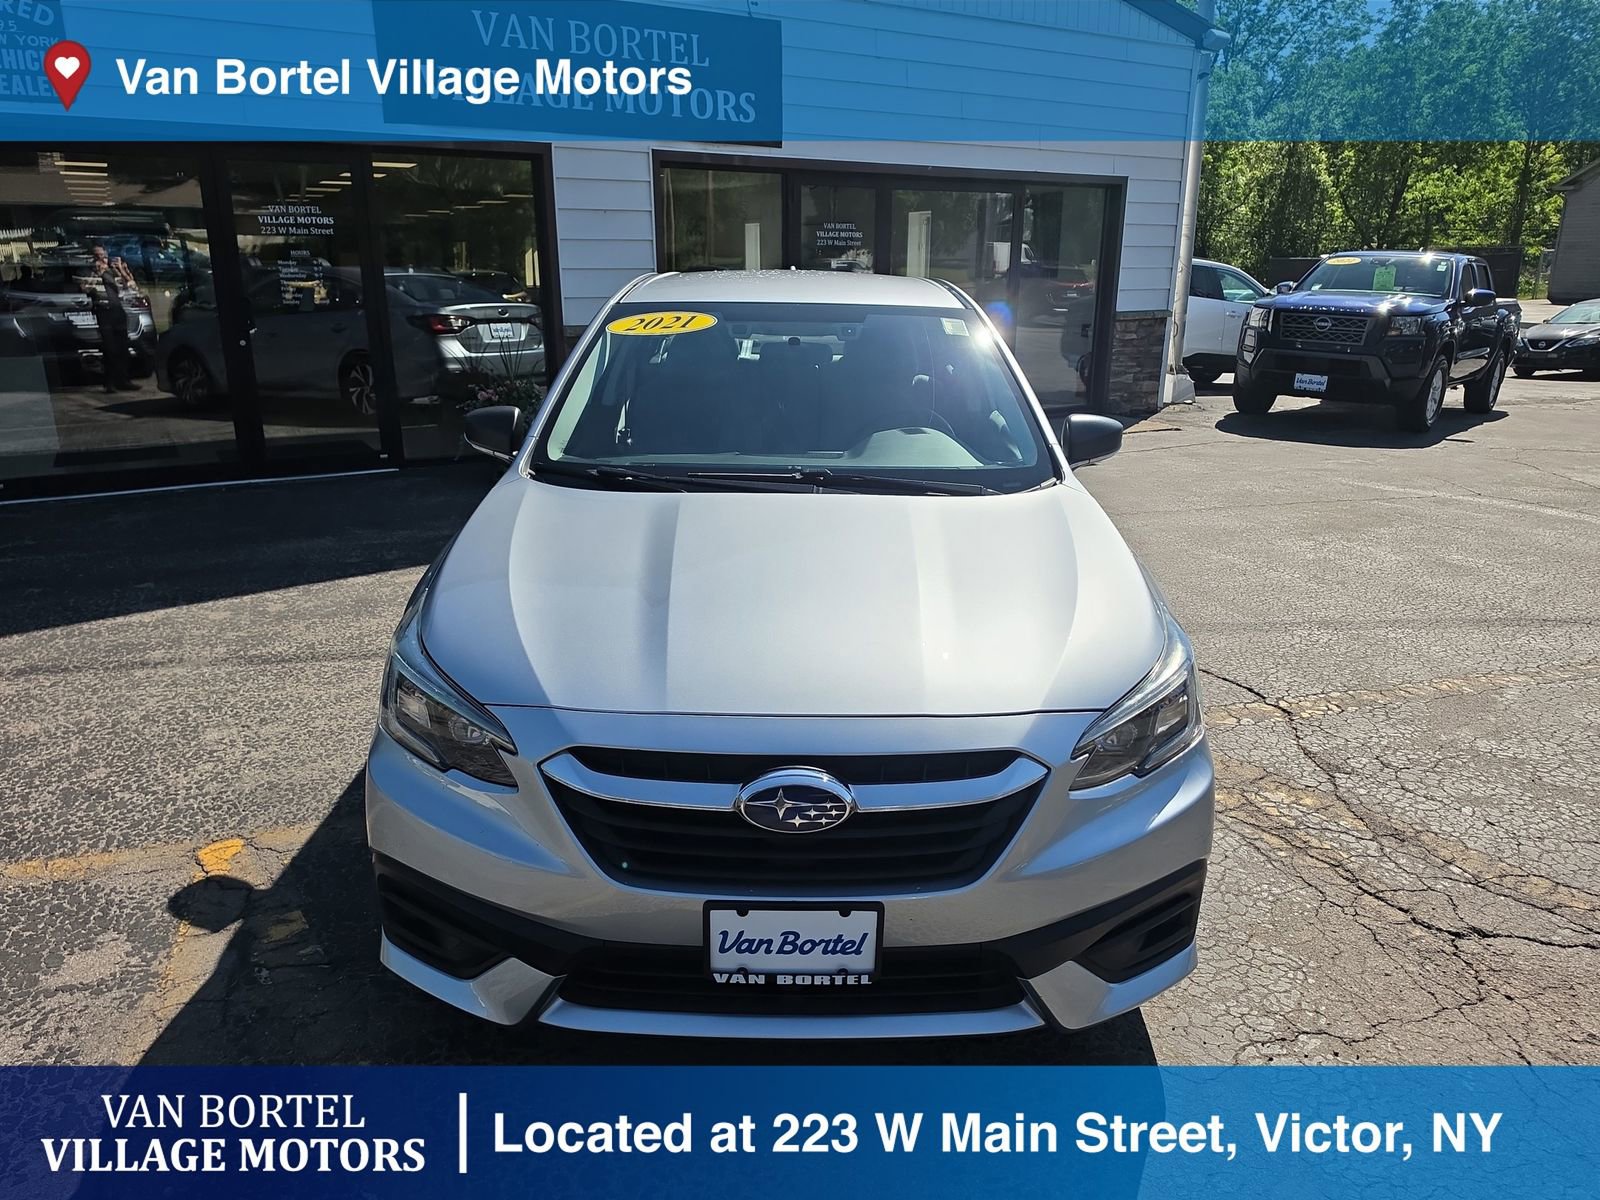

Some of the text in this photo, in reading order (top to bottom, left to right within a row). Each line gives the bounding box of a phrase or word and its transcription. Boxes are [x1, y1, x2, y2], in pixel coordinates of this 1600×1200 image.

[472, 10, 710, 67] VAN BORTEL
[420, 64, 593, 111] VLAGE
[268, 205, 322, 214] VAN BORTEL
[258, 215, 335, 225] VILLAGE MOTORS
[261, 226, 334, 235] 223 W Main Street
[624, 315, 697, 331] 2021
[718, 929, 869, 955] Van Bortel
[713, 972, 873, 985] VAN BORTEL
